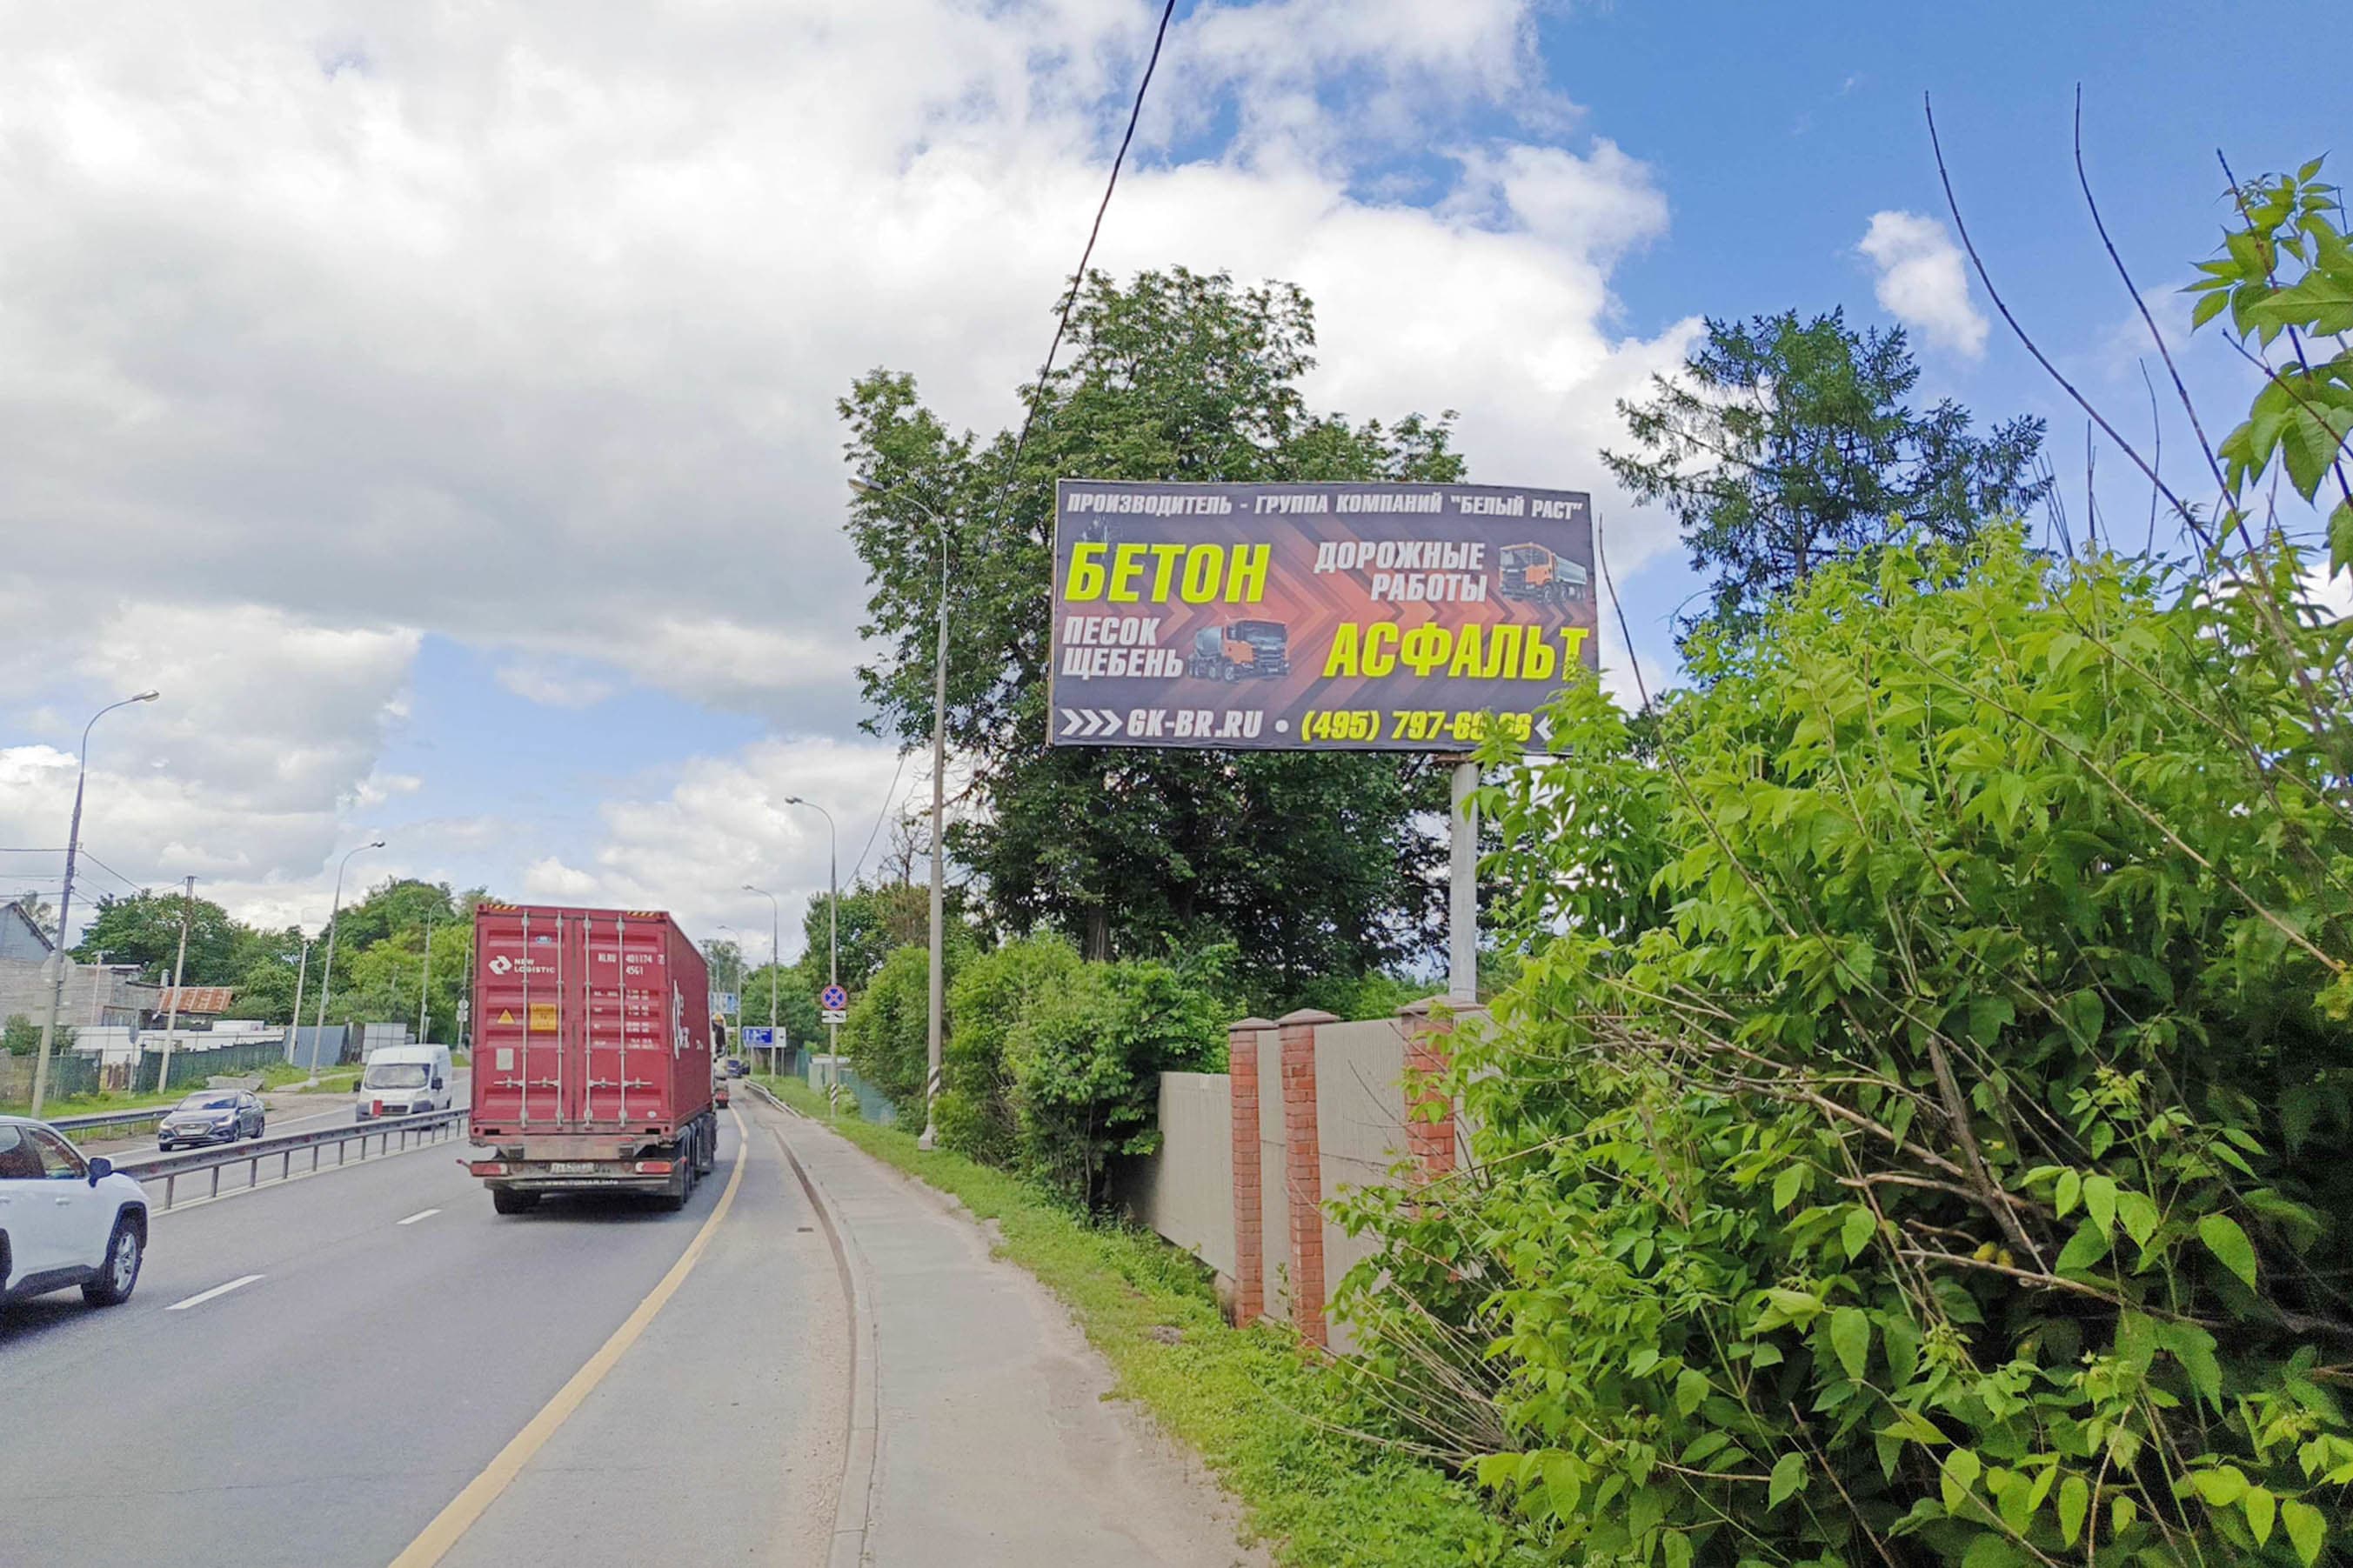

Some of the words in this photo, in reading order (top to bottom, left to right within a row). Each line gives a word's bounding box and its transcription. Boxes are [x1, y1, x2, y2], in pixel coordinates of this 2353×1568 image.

[1066, 493, 1232, 517] ПРОИЗВОДИТЕЛЬ
[1254, 495, 1327, 514] ГРУППА
[1336, 492, 1443, 514] КОМПАНИЙ
[1451, 495, 1524, 517] "БЕЛЫЙ
[1531, 499, 1582, 520] РАСТ"
[1064, 542, 1271, 604] БЕТОН
[1314, 541, 1486, 574] ДОРОЖНЫЕ
[1370, 573, 1487, 603] РАБОТЫ
[1062, 616, 1160, 646] ПЕСОК
[1061, 648, 1184, 679] ЩЕБЕНЬ
[1322, 621, 1589, 682] АСФАЛЬТ
[1126, 709, 1264, 738] GK-BR.RU
[1300, 710, 1380, 742] (495)
